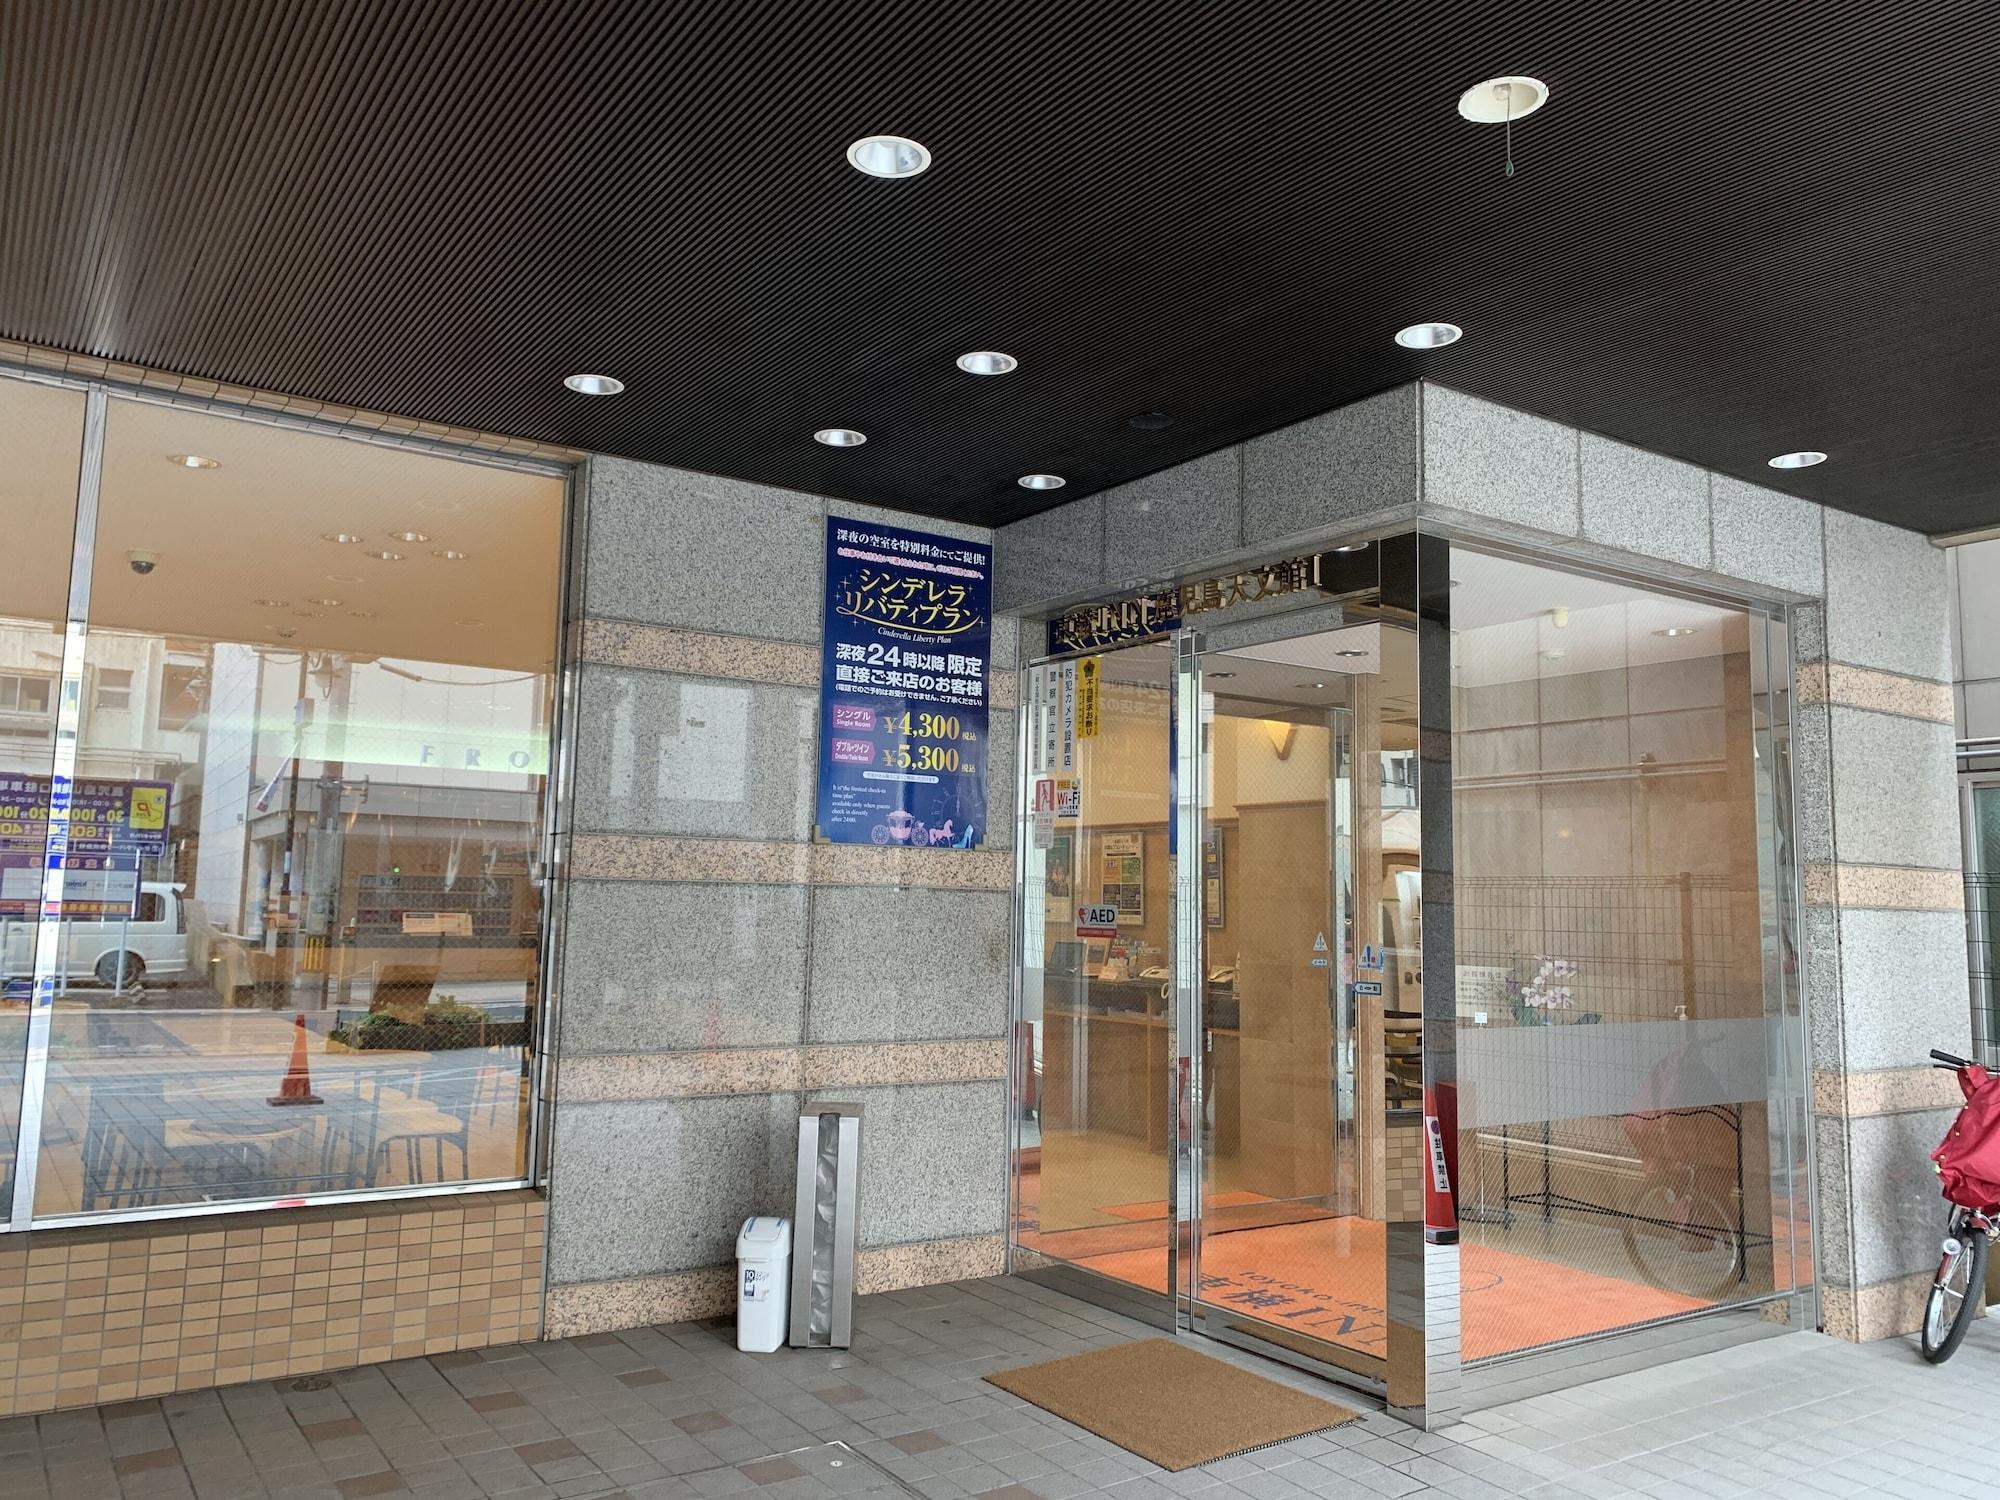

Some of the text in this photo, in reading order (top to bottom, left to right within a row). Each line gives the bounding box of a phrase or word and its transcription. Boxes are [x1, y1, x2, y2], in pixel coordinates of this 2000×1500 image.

[860, 569, 966, 606] シンデレラ
[840, 591, 980, 633] リバティプラン
[878, 626, 952, 644] Cinderella Liberty Plan
[835, 664, 983, 697] 直接ご来店のお客様
[836, 718, 853, 727] Single
[837, 708, 871, 721] シングル
[883, 711, 960, 740] ¥4,300
[1063, 668, 1073, 767] 防犯カメラ設置店
[882, 743, 959, 773] ¥5,300
[1057, 791, 1081, 805] Wi-Fi
[1090, 908, 1115, 922] AED
